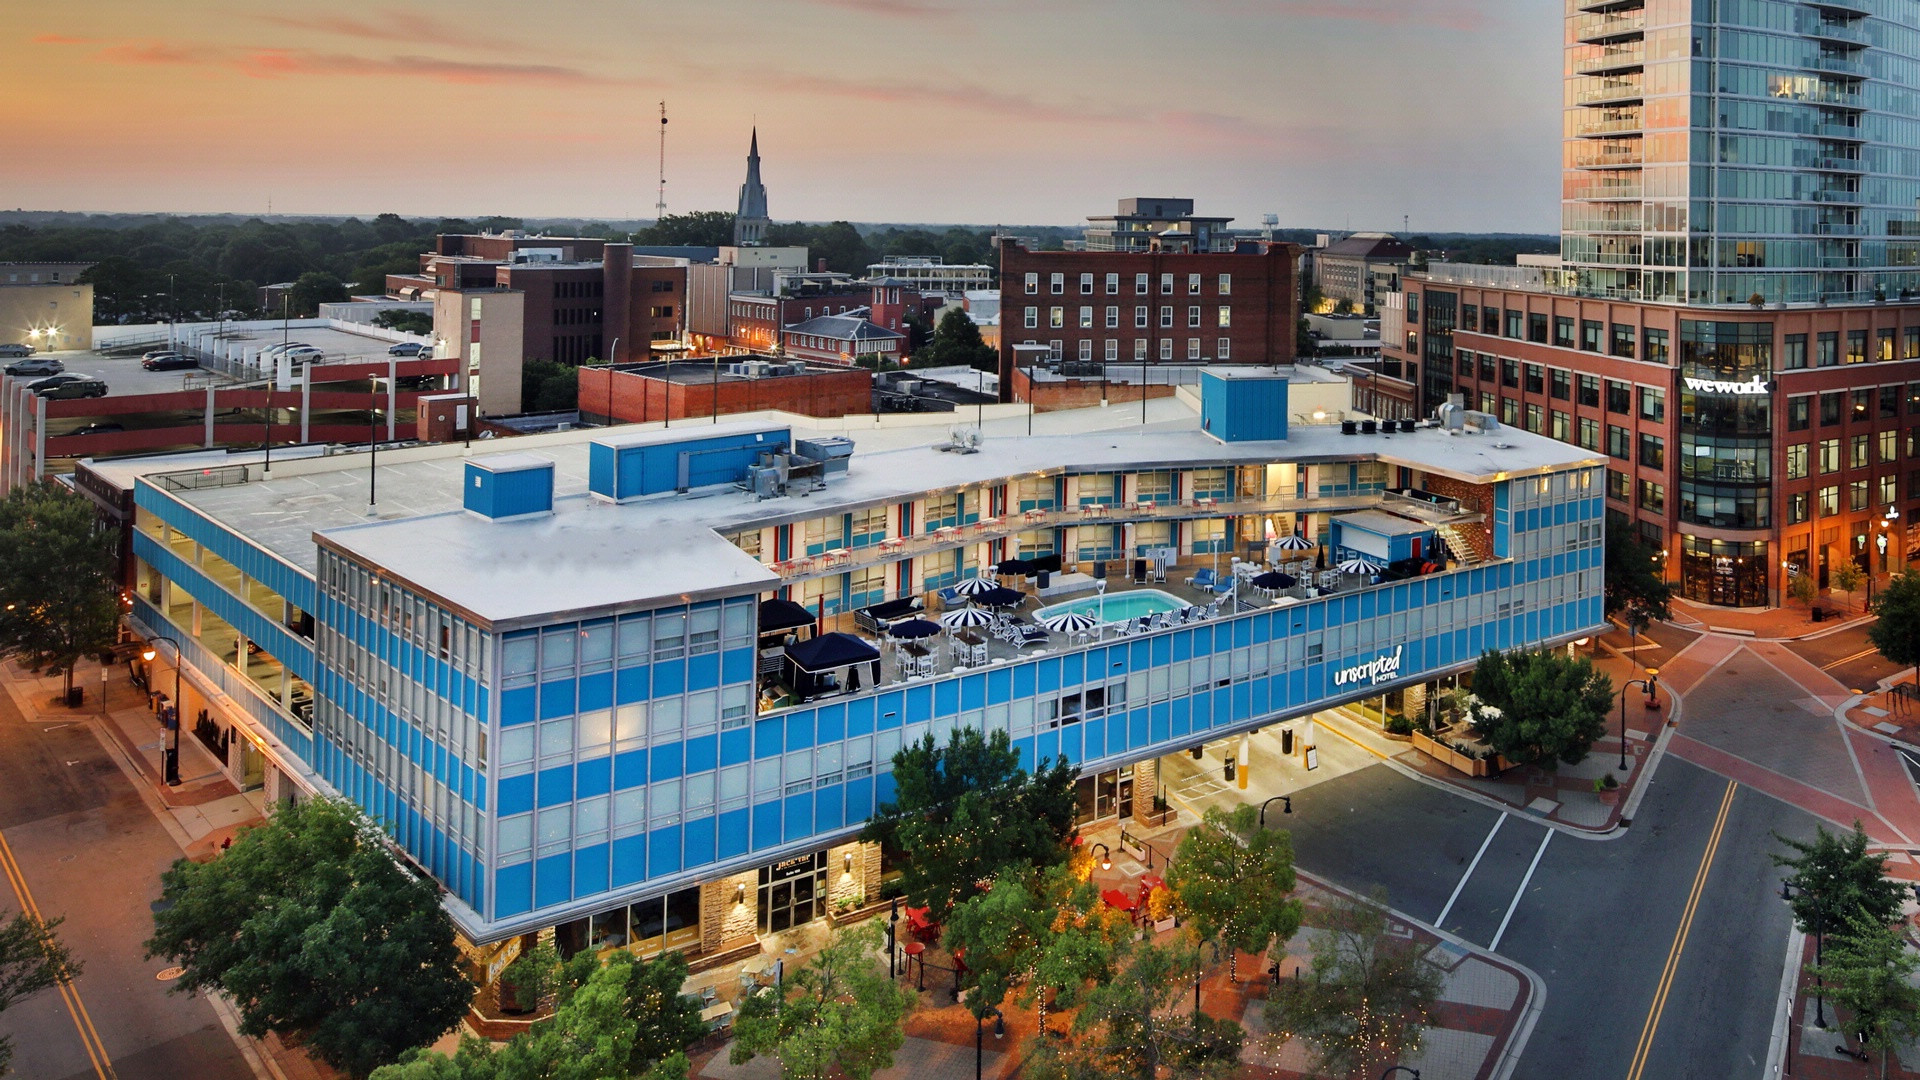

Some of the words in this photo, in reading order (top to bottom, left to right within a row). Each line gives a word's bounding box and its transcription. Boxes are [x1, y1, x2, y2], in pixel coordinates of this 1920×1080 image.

[1683, 375, 1769, 395] wework
[1334, 644, 1402, 686] unscripted
[1376, 672, 1398, 682] HOTEL
